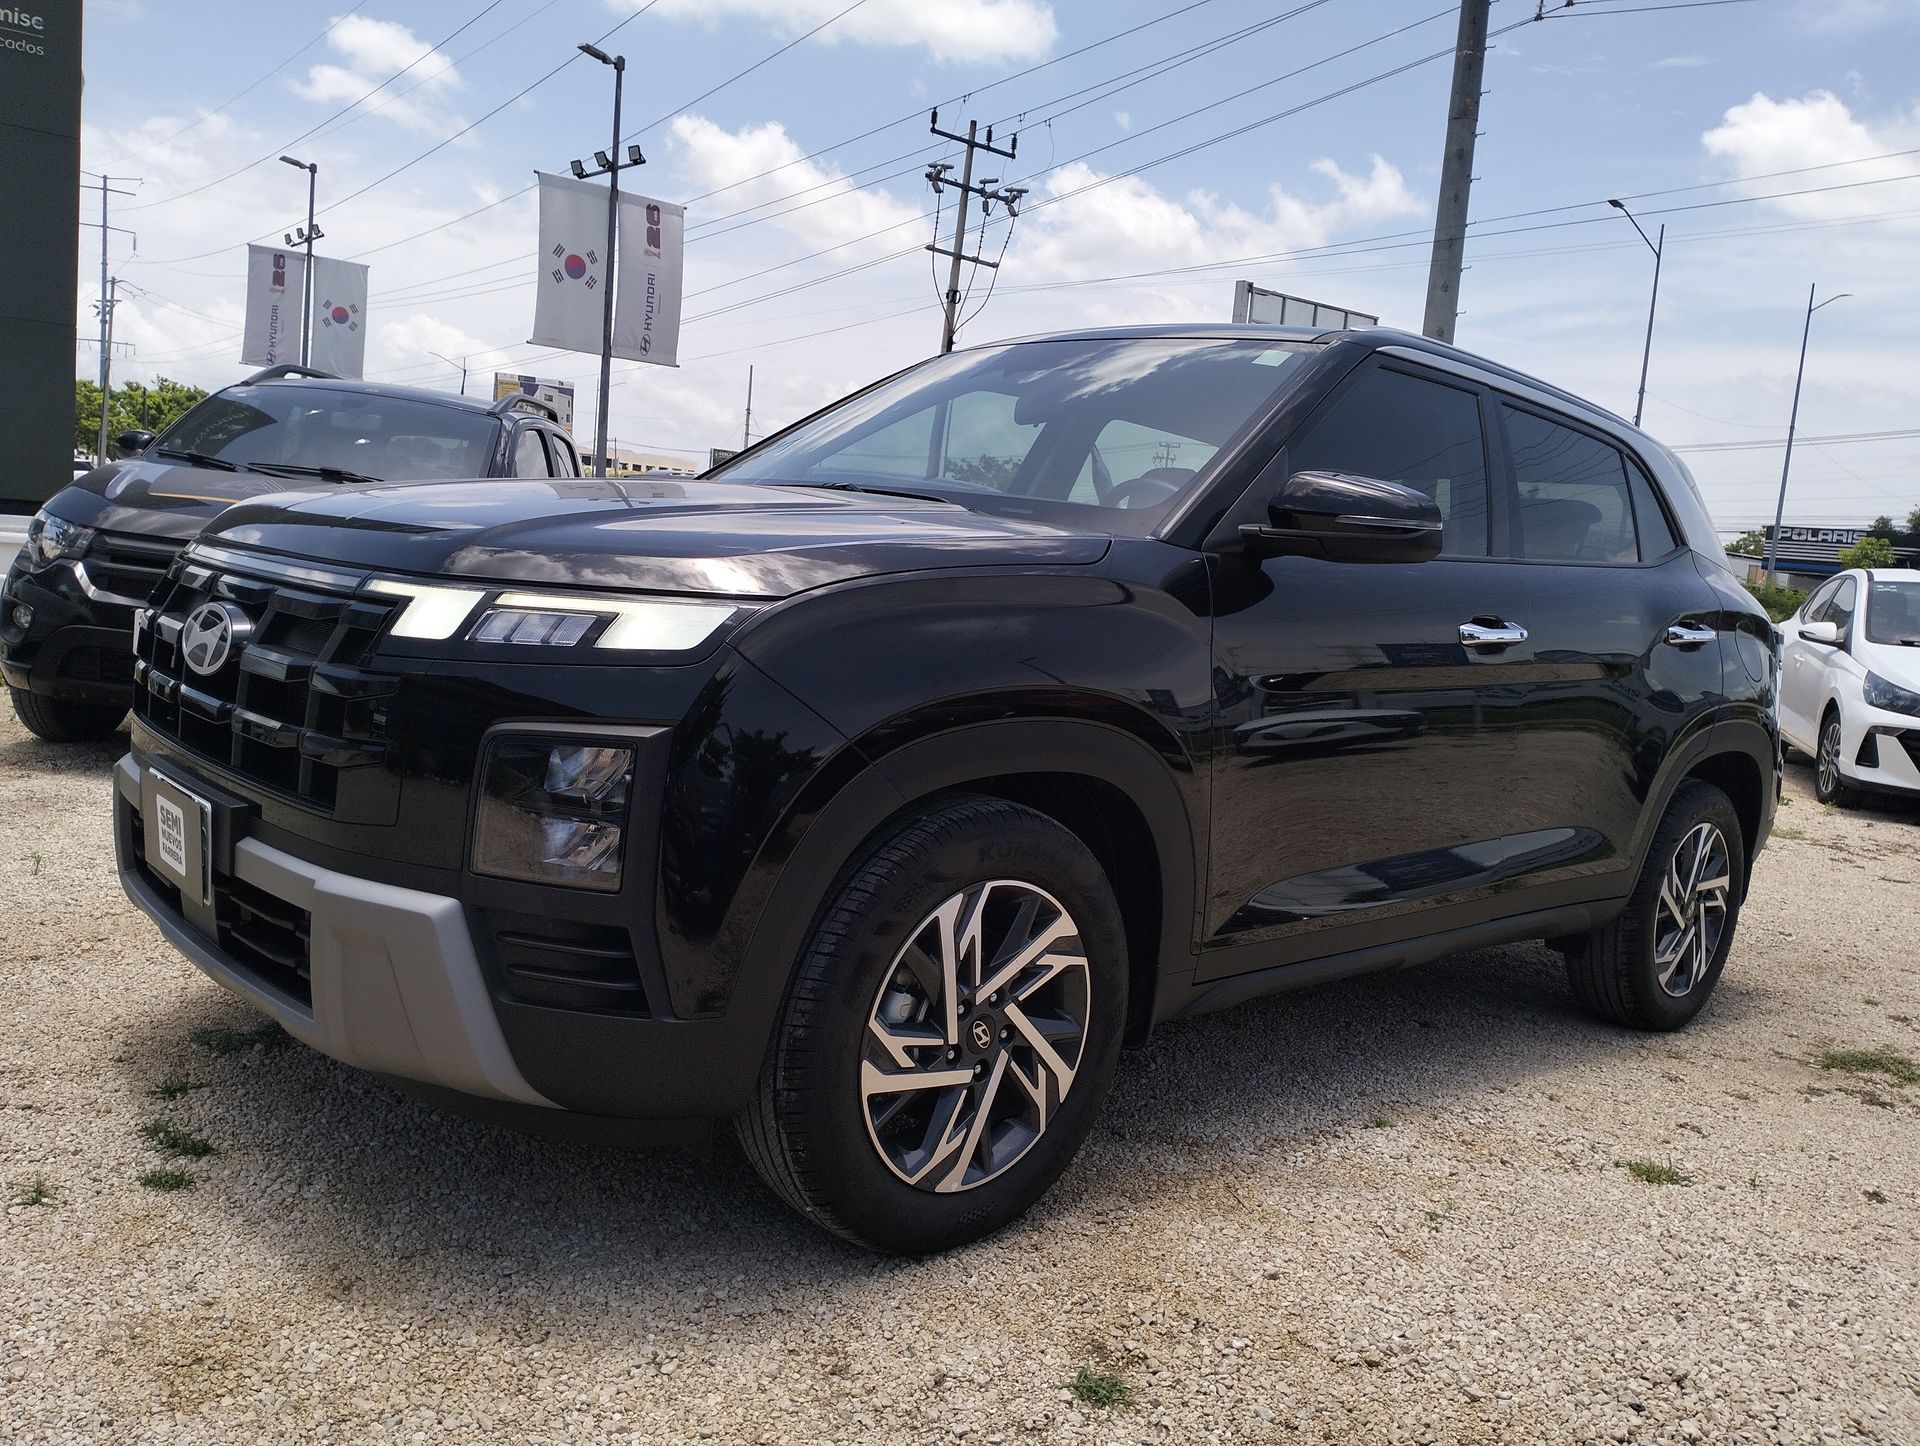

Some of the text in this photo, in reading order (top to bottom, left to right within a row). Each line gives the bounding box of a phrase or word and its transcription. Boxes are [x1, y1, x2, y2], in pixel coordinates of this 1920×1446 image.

[644, 273, 656, 331] HYUNDAI
[269, 304, 280, 348] HYUNDAI
[1778, 528, 1867, 543] POLARIS
[160, 804, 182, 838] SEMI
[161, 827, 183, 852] NUEVOS
